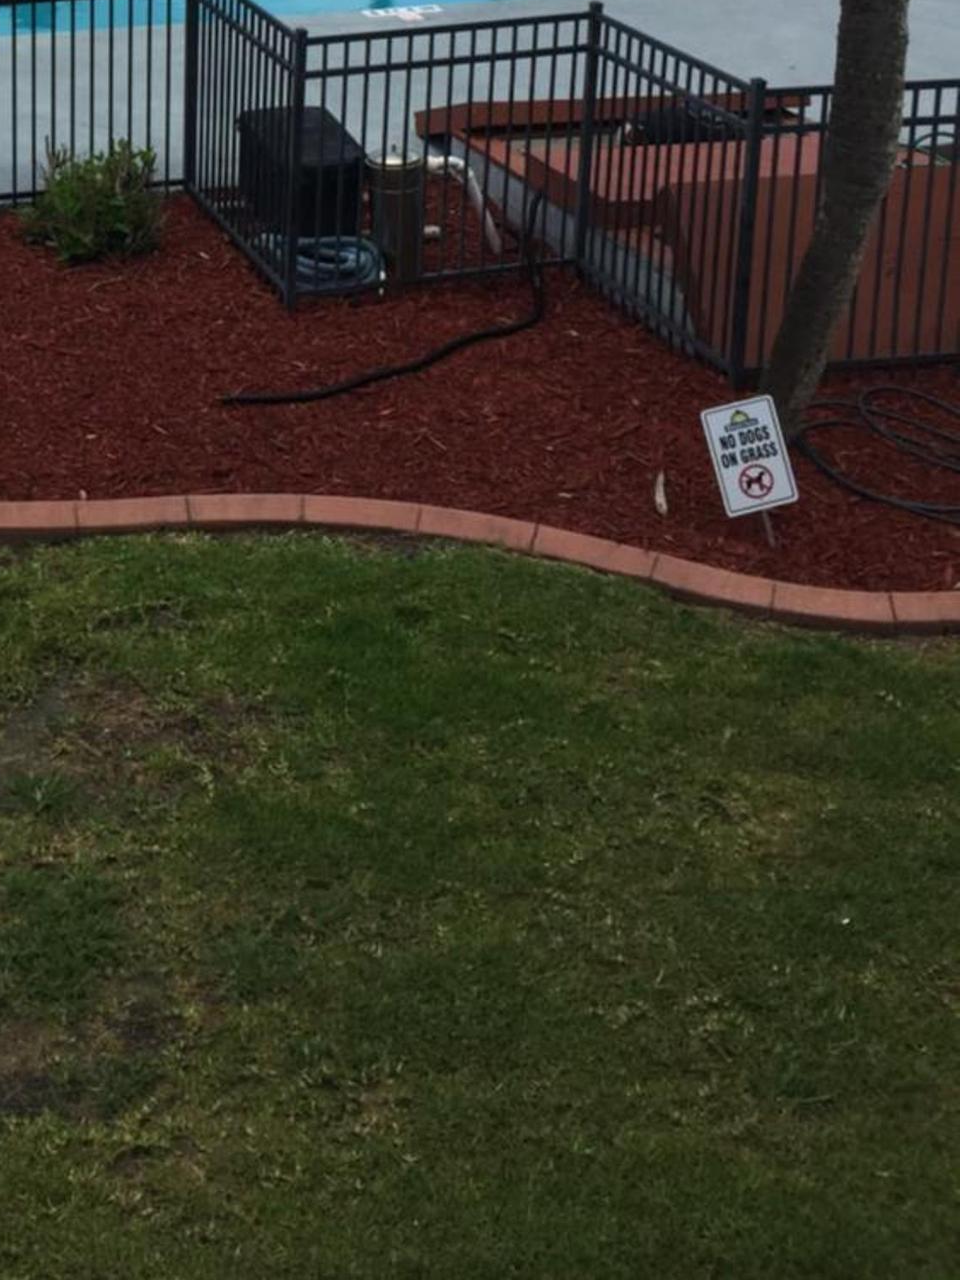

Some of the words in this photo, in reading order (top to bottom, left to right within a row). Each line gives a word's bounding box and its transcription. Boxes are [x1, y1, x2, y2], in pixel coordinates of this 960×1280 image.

[719, 434, 736, 449] NO
[738, 425, 770, 446] DOGS
[721, 452, 738, 469] ON
[740, 441, 778, 463] GRASS
